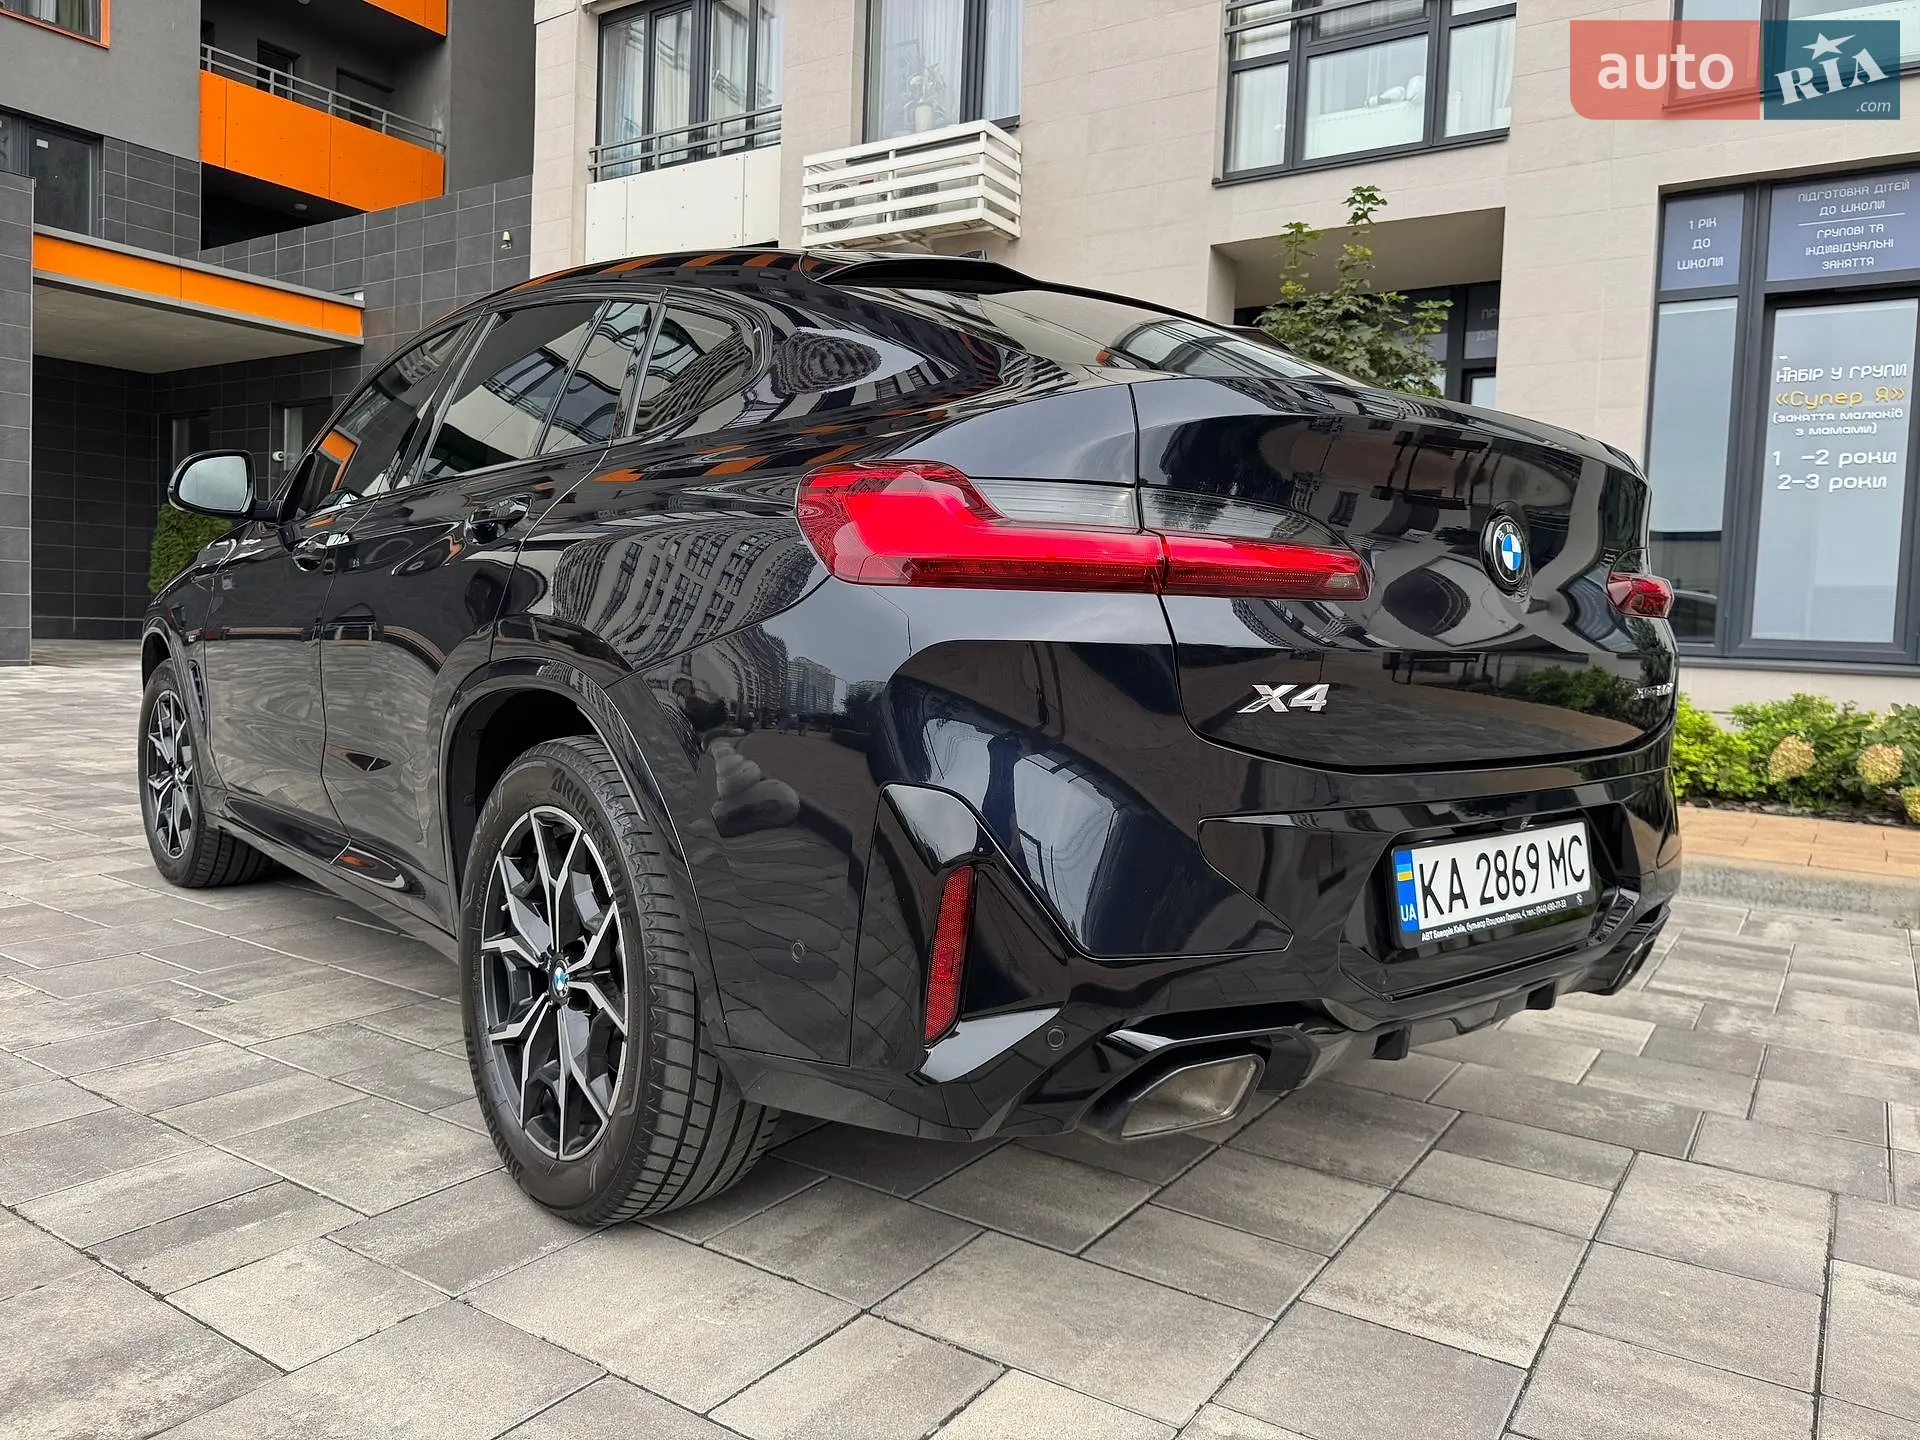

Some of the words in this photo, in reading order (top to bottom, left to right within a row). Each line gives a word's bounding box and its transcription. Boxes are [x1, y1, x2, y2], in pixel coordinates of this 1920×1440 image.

[1798, 185, 1870, 203] ПІДГОТОВКА
[1873, 178, 1911, 195] ДІТЕЙ
[1819, 205, 1837, 217] ДО
[1840, 199, 1886, 214] ШКОЛИ
[1688, 219, 1695, 231] 1
[1697, 216, 1718, 230] РІК
[1816, 225, 1865, 239] ГРУПОВІ
[1868, 223, 1885, 234] ТА
[1691, 237, 1712, 250] ДО
[1805, 238, 1894, 256] ІНДИВІДУАЛЬНІ
[1676, 255, 1725, 271] ШКОЛИ
[1821, 256, 1875, 270] ЗАНЯТТЯ
[1775, 366, 1825, 384] НАБІР
[1830, 366, 1843, 380] У
[1849, 363, 1908, 379] ГРУПИ
[1838, 451, 1898, 469] роки
[1828, 476, 1888, 493] роки
[1235, 683, 1331, 714] X4
[1418, 857, 1469, 919] KA
[1475, 842, 1540, 906] 2869
[1547, 834, 1586, 890] MC
[1400, 904, 1418, 923] UA
